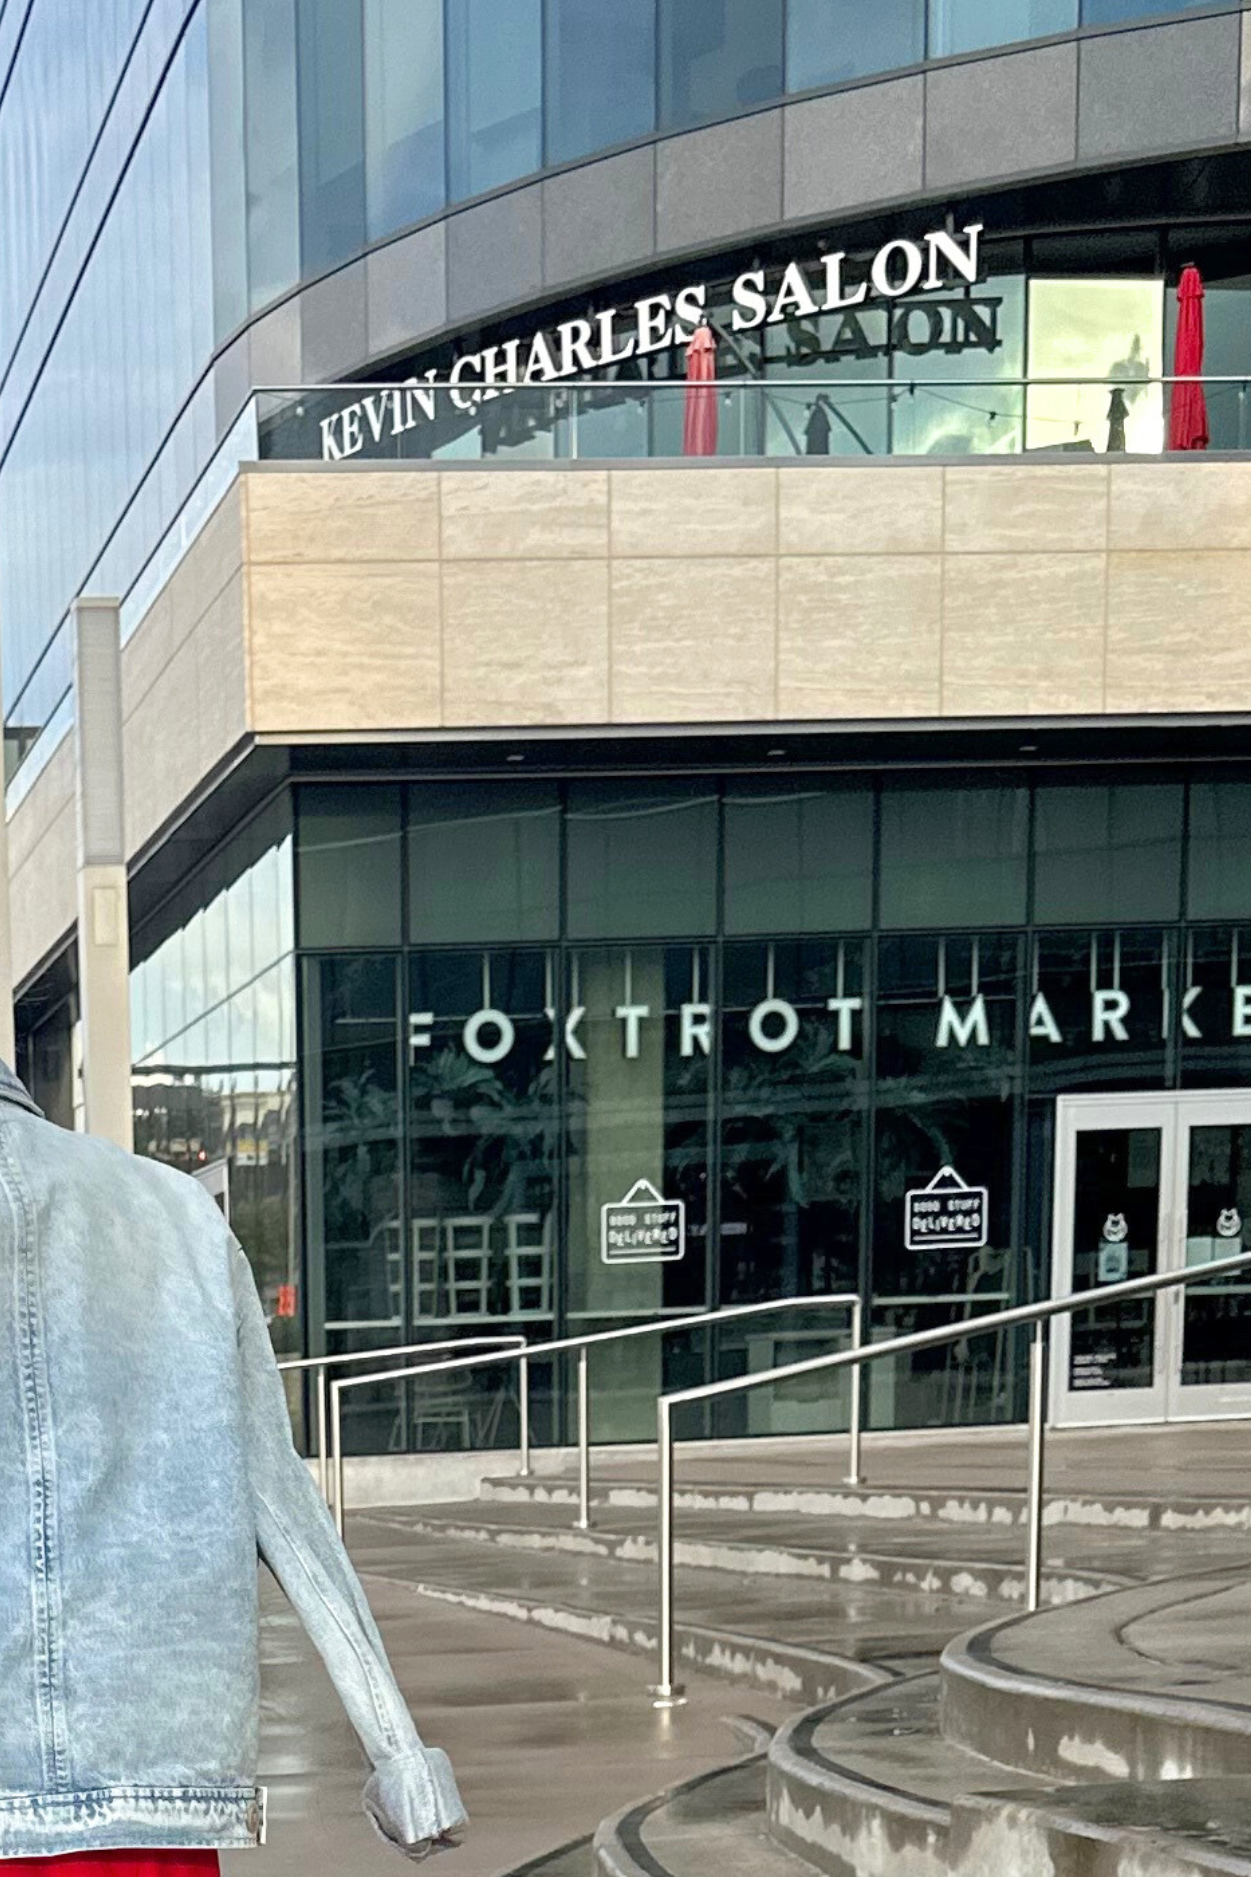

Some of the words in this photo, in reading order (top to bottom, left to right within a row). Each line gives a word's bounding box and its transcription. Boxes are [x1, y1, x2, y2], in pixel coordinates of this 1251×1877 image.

[319, 368, 437, 461] KEVIN
[450, 284, 707, 410] CHARLES
[731, 223, 983, 331] SALON
[409, 997, 862, 1066] FOXTROT
